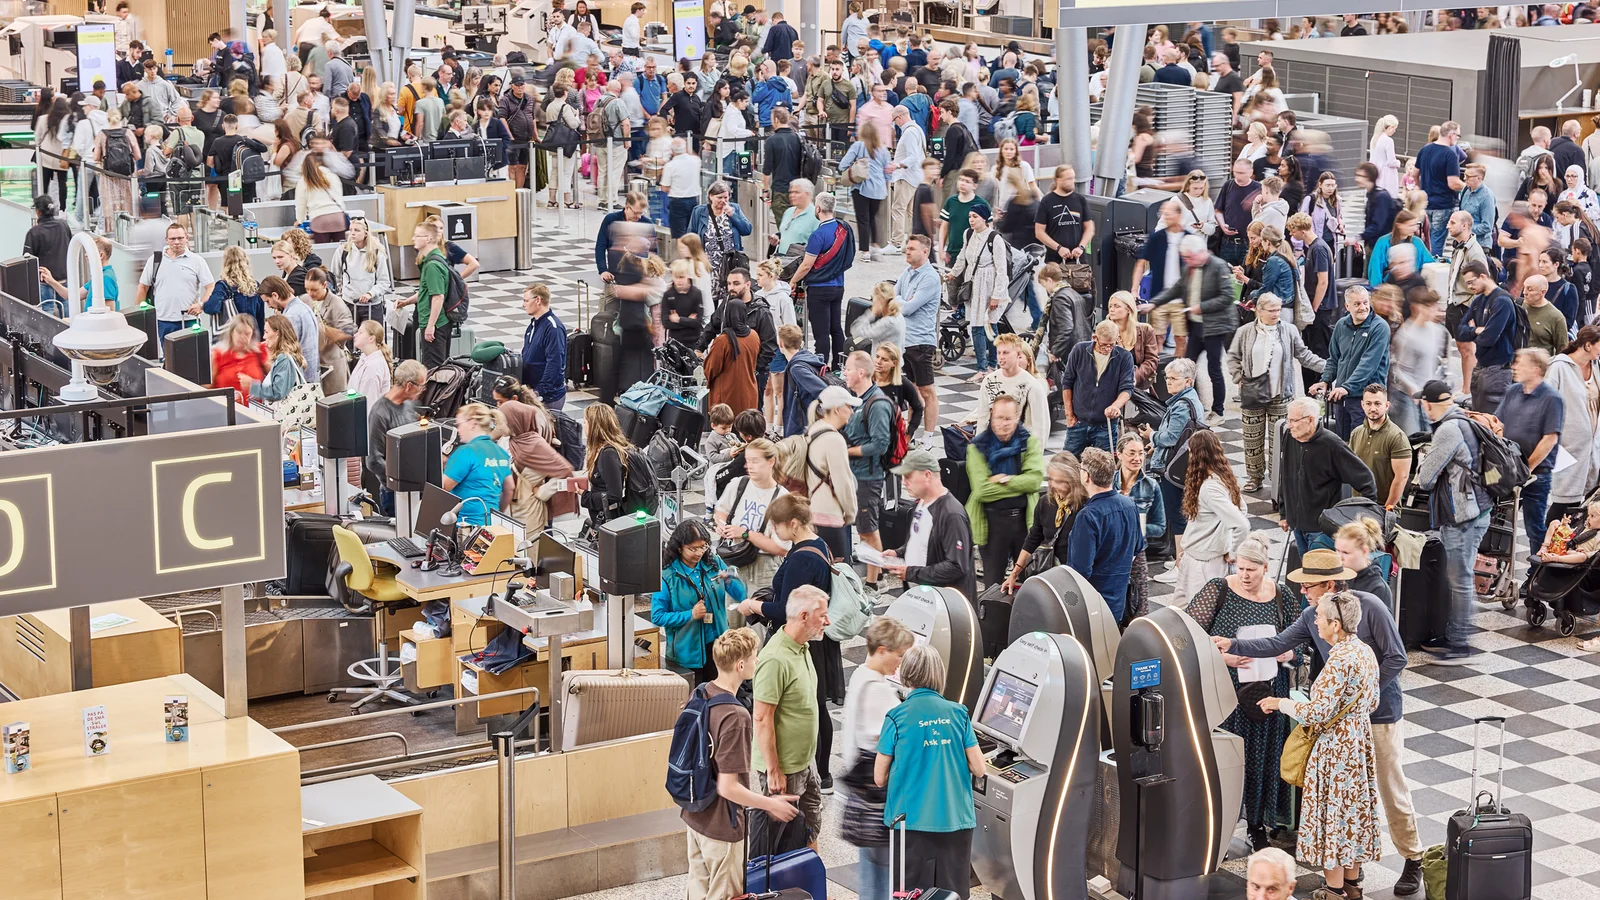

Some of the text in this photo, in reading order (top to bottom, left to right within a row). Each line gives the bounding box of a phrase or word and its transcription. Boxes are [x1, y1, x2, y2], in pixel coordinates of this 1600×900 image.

[182, 472, 234, 550] C
[744, 499, 767, 516] VAC
[1019, 638, 1027, 646] Easy
[918, 718, 951, 727] Service
[924, 739, 938, 747] Ask
